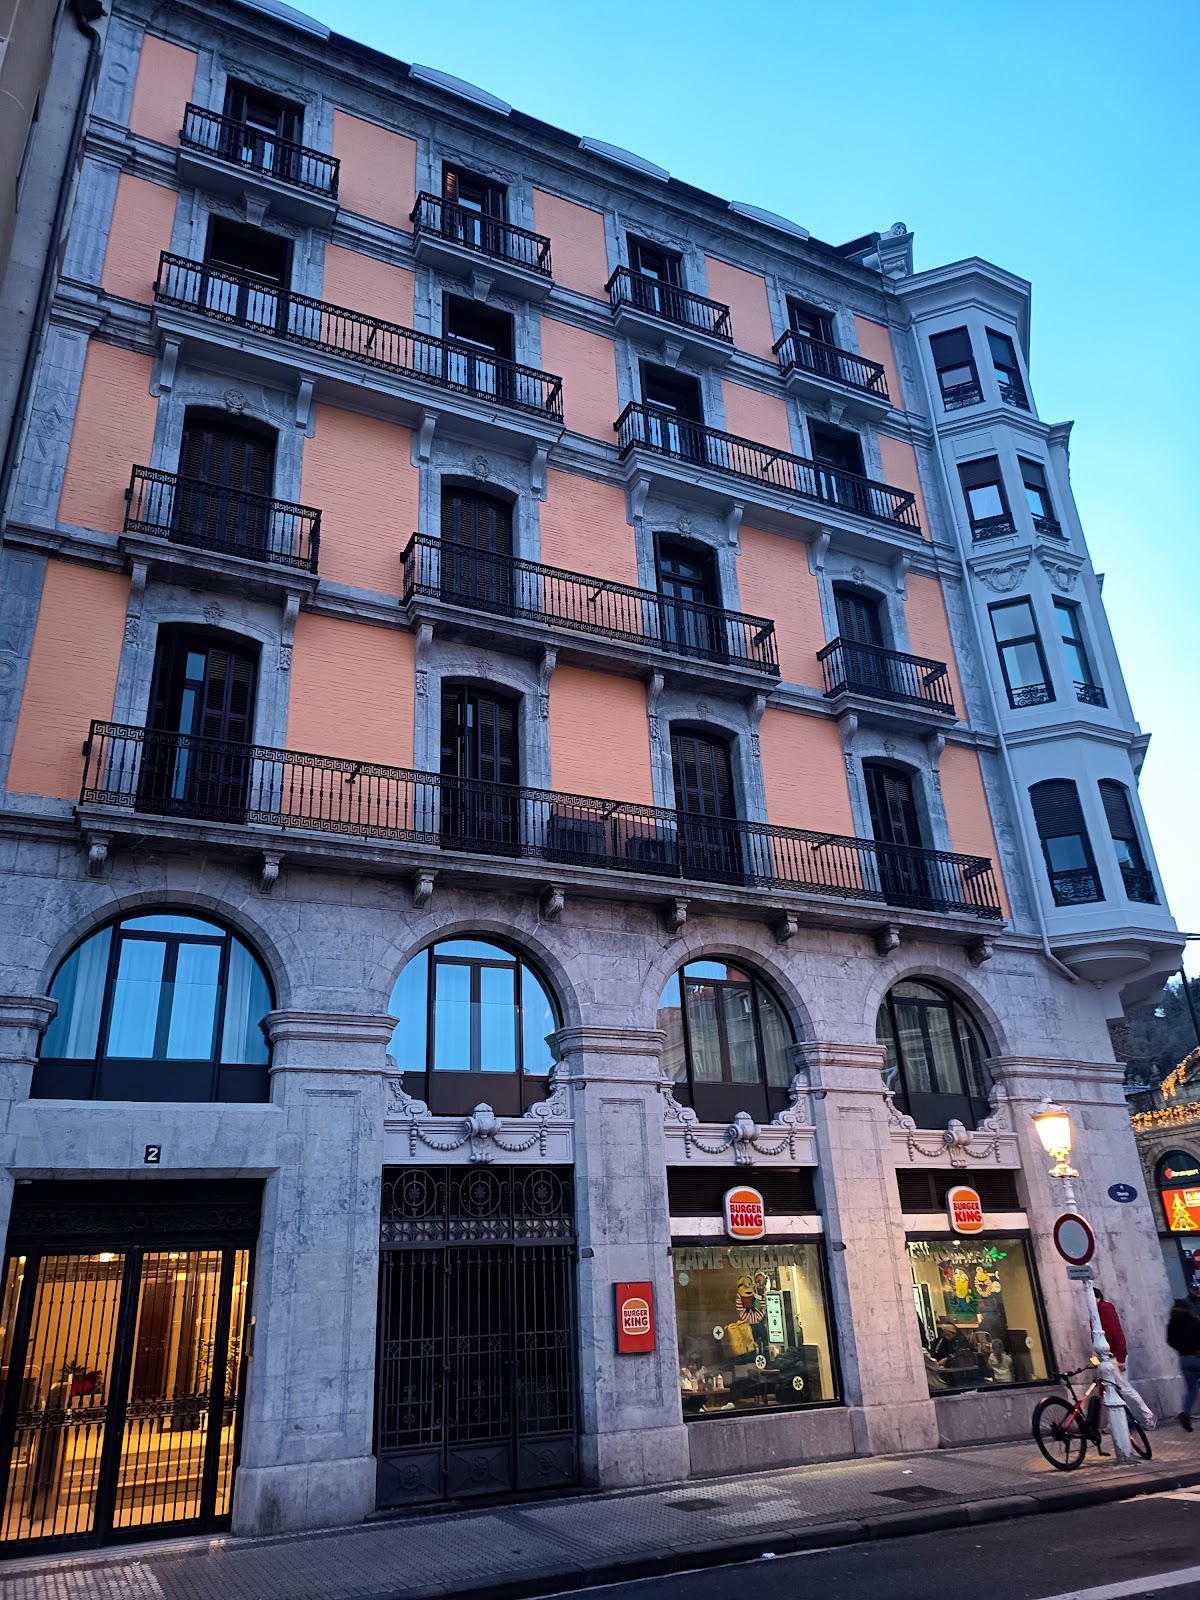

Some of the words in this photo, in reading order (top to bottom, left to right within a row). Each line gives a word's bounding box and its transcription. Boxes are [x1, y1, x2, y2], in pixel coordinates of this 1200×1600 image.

[147, 1148, 158, 1160] 2
[730, 1204, 762, 1213] BURGER
[953, 1202, 980, 1210] BURGER
[731, 1213, 763, 1226] KING
[955, 1210, 982, 1222] KING
[729, 1246, 806, 1269] GRILLING
[623, 1309, 648, 1317] BURGER
[624, 1317, 648, 1327] KING
